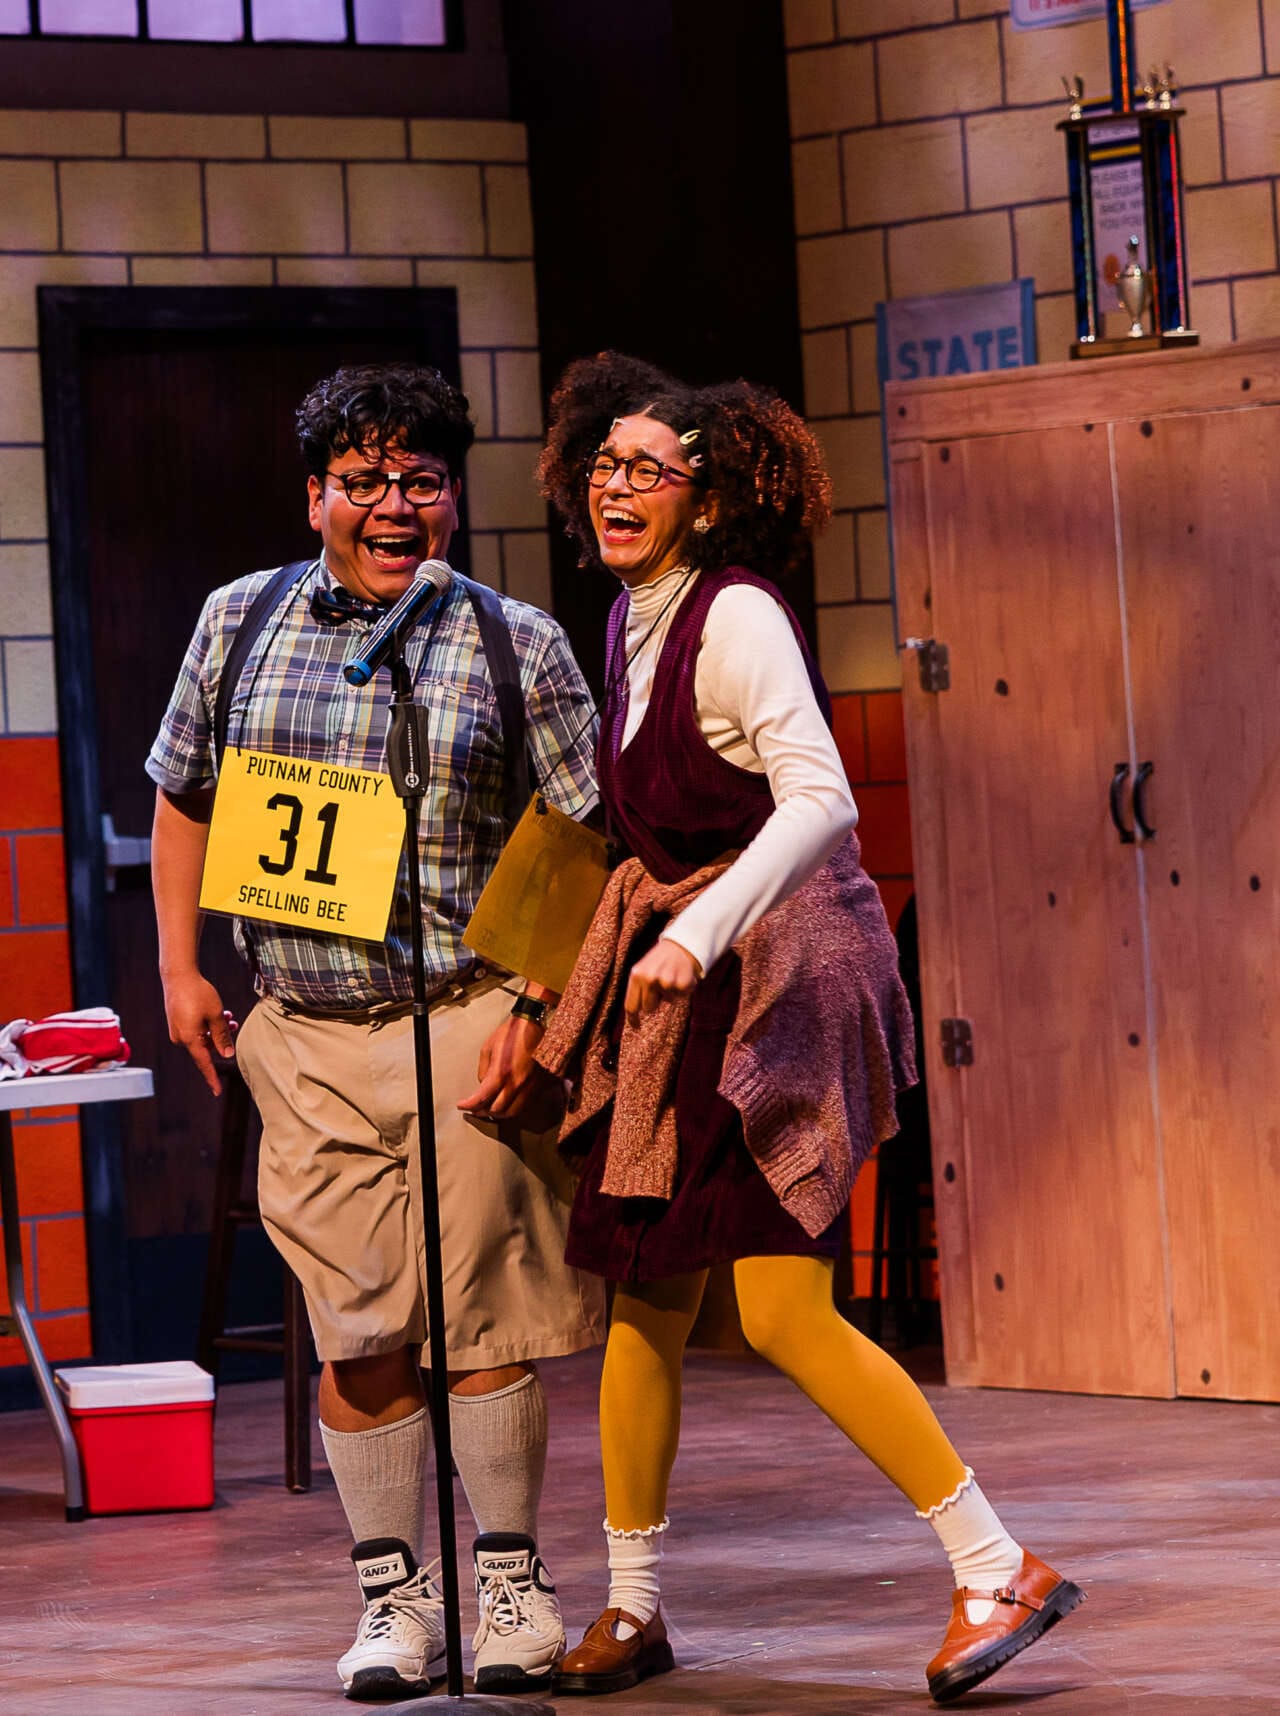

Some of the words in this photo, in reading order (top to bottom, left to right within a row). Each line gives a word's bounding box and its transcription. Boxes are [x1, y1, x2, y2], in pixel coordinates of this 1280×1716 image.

[897, 325, 1020, 382] STATE
[246, 755, 312, 785] PUTNAM
[318, 768, 385, 797] COUNTY
[258, 792, 340, 887] 31
[237, 884, 310, 916] SPELLING
[316, 898, 348, 922] BEE
[365, 1565, 389, 1577] AND
[391, 1562, 398, 1571] 1
[487, 1560, 517, 1570] AND
